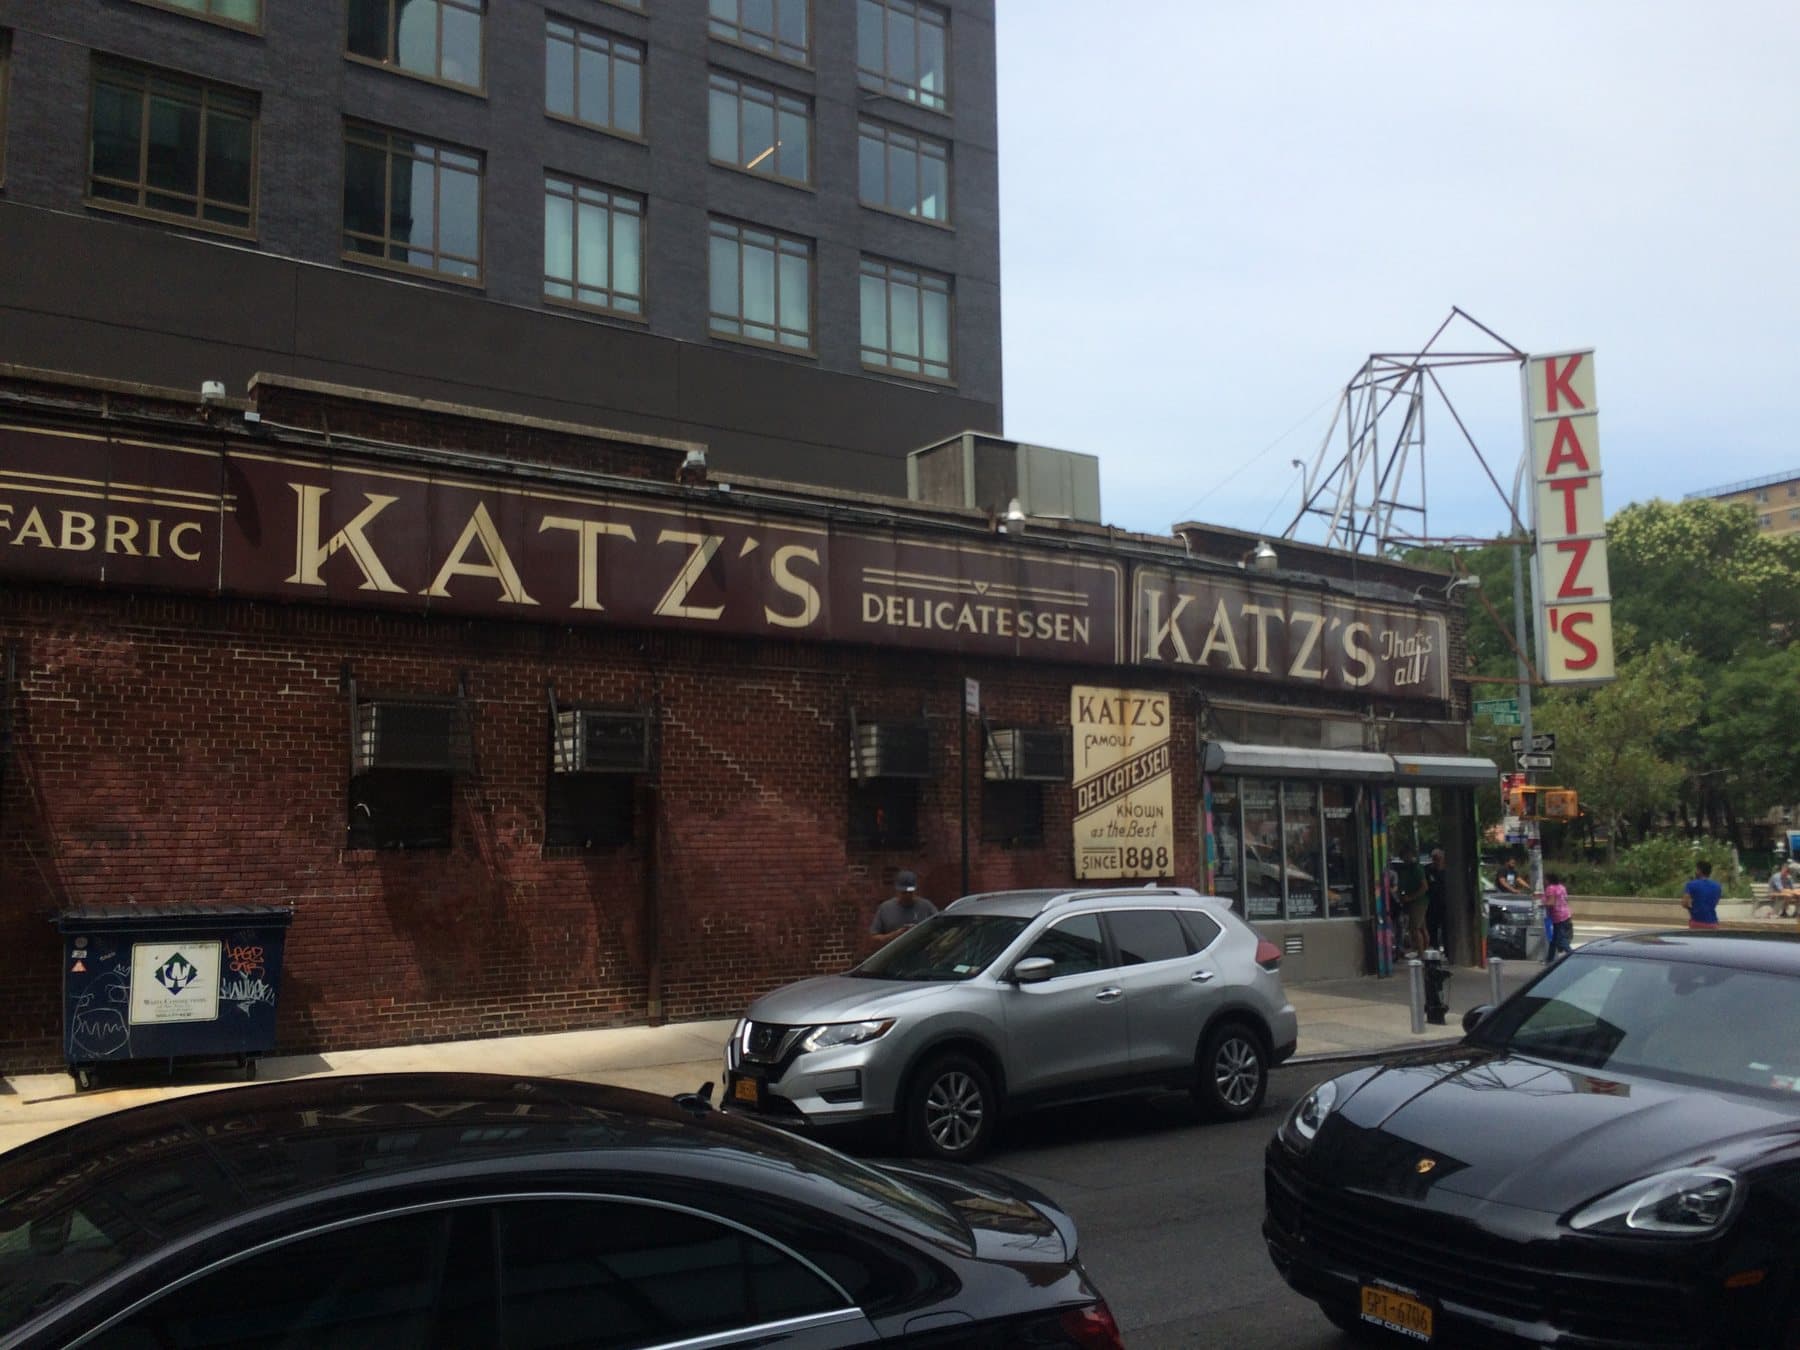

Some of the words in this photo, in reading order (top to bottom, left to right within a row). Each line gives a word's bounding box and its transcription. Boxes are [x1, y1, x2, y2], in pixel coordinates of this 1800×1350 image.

[1544, 353, 1599, 670] KATZ'S
[283, 482, 822, 628] KATZ'S
[862, 592, 1090, 645] DELICATESSEN
[1143, 588, 1377, 687] KATZ'S
[1379, 628, 1433, 661] That's
[1078, 695, 1166, 727] KATZ'S
[1077, 746, 1169, 814] DELICATESSEN
[1090, 828, 1104, 839] as
[1106, 819, 1126, 838] the
[1125, 820, 1158, 838] Best
[1116, 804, 1165, 819] KNOWN
[1081, 855, 1118, 870] SINCE
